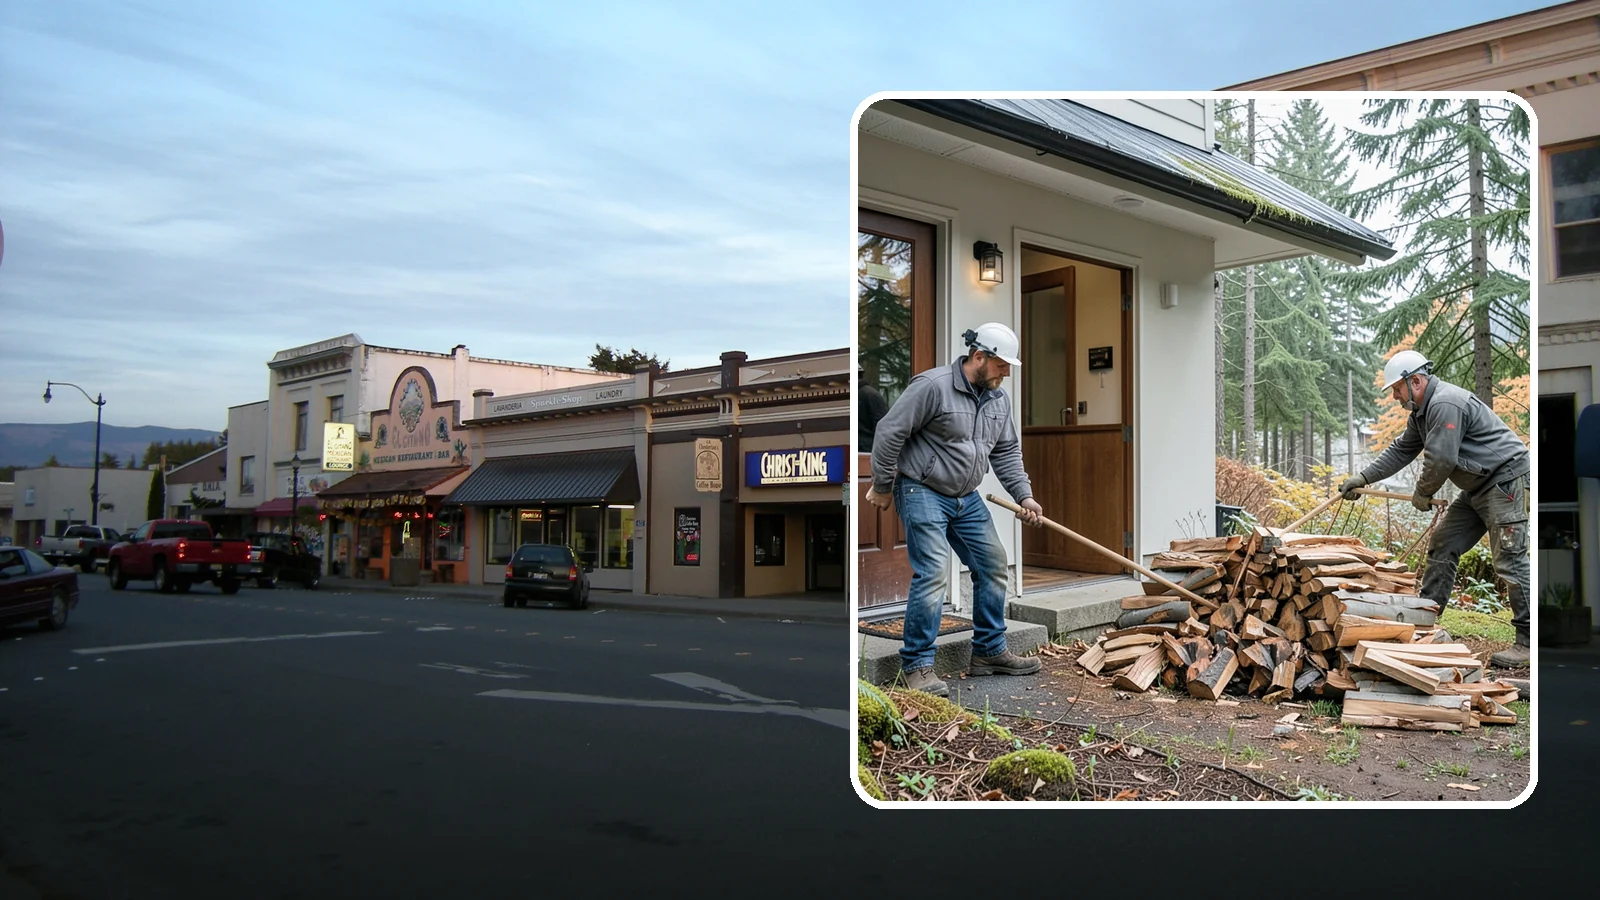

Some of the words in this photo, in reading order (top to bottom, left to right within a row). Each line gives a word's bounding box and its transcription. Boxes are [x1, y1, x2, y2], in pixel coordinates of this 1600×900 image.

[562, 394, 582, 405] Shop
[595, 389, 623, 400] LAUNDRY
[493, 402, 522, 412] LAVANDERIA
[373, 455, 396, 464] MEXICAN
[397, 451, 433, 462] RESTAURANT
[437, 450, 450, 459] BAR
[799, 450, 827, 476] KING
